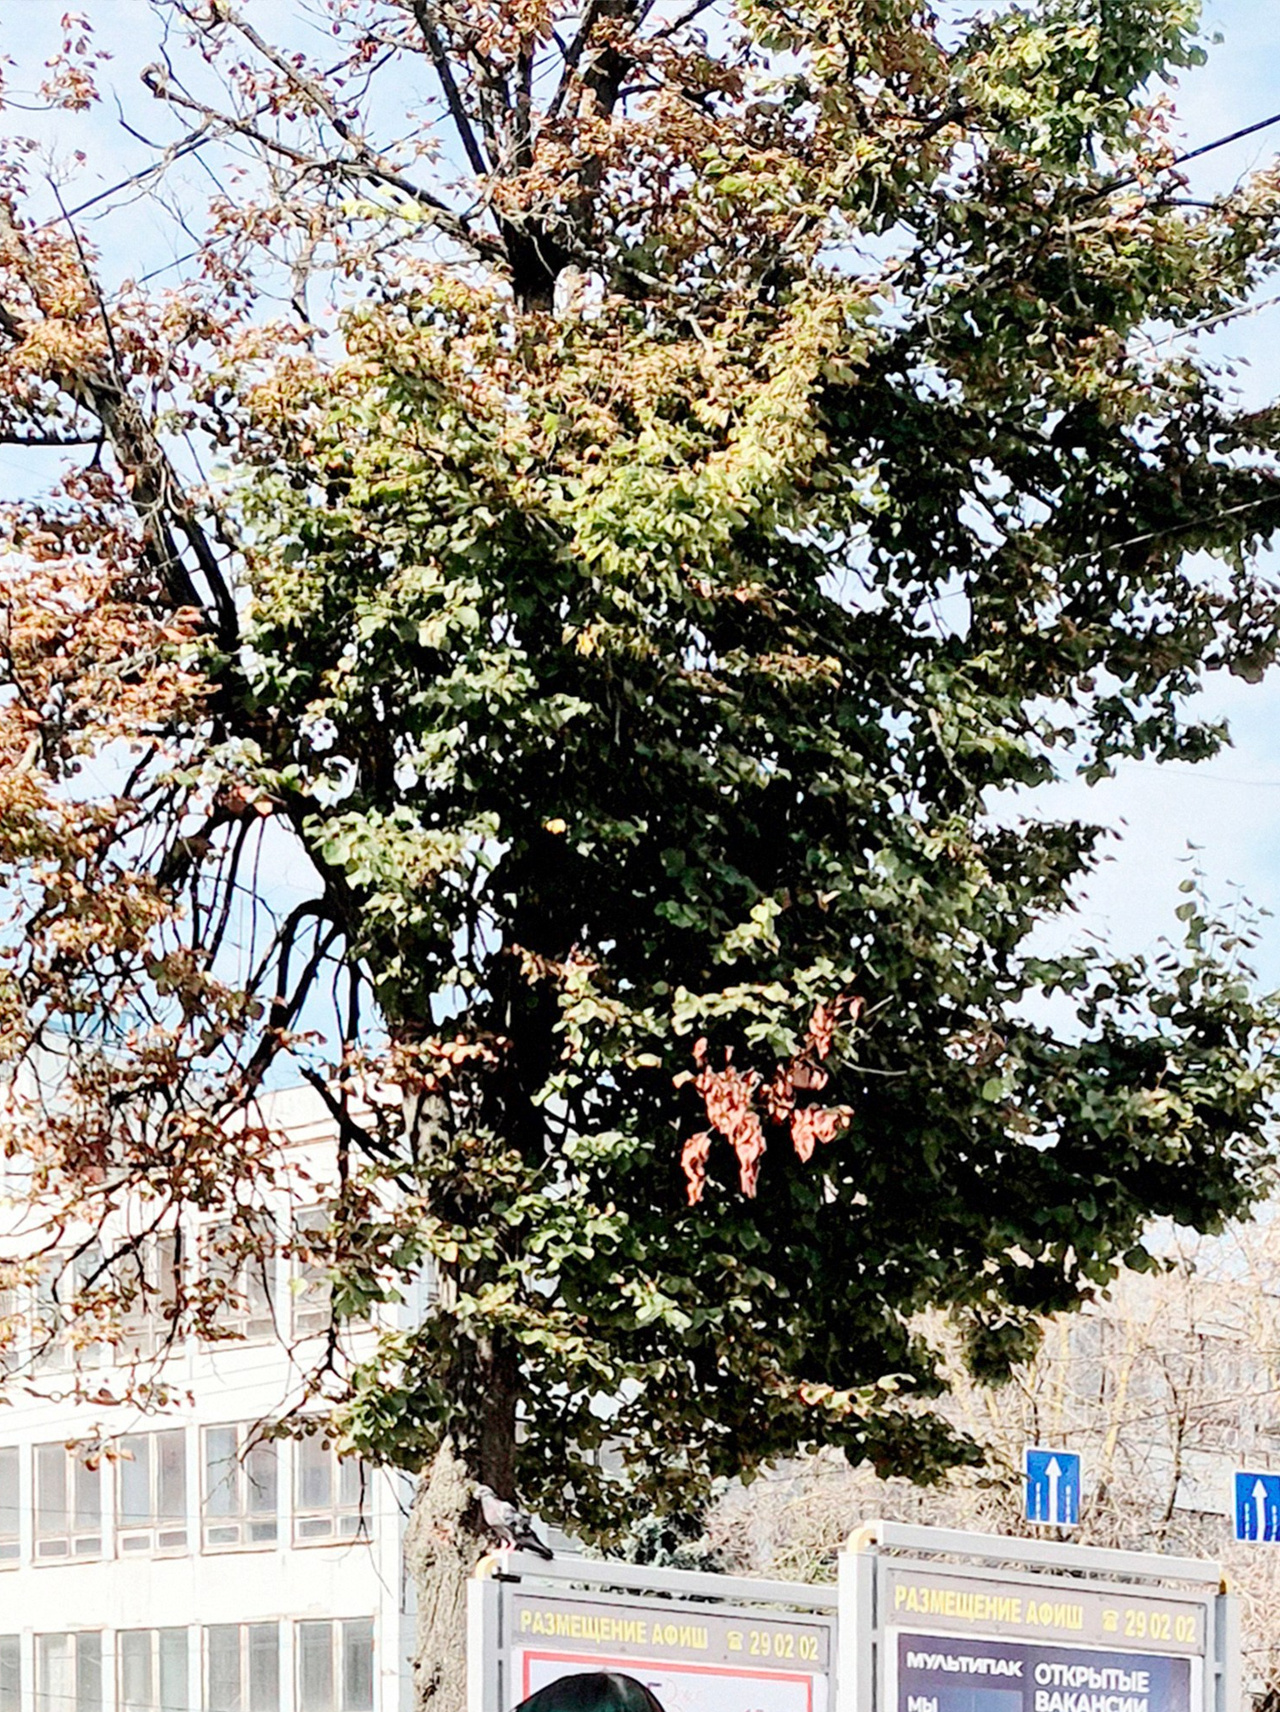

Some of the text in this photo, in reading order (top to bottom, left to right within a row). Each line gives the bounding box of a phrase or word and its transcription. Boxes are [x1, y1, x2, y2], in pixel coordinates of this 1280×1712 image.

[894, 1585, 1197, 1643] РАЗМЕЩЕНИЕ АФИШ 29 02 02
[519, 1609, 820, 1662] РАЗМЕЩЕНИЕ АФИШ 29 02 02
[906, 1651, 1024, 1678] МУЛЬТИПАК
[1034, 1662, 1151, 1694] ОТКРЫТЫЕ
